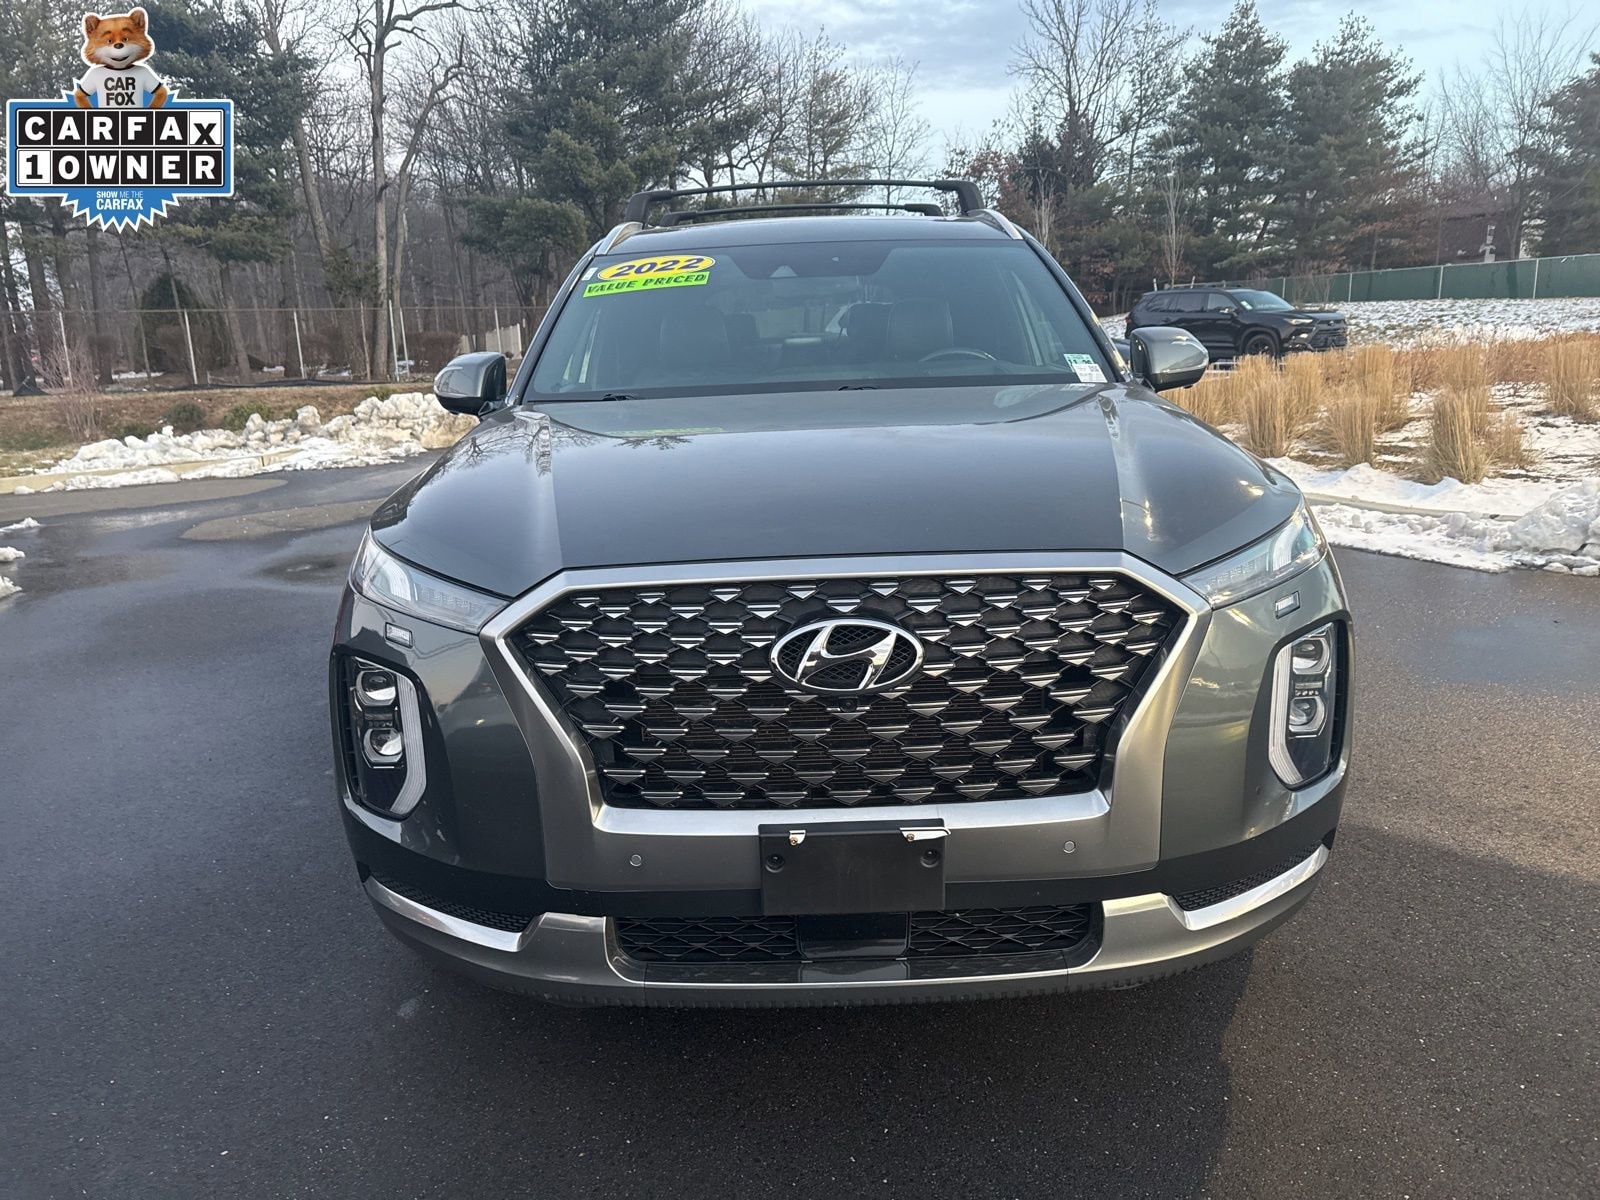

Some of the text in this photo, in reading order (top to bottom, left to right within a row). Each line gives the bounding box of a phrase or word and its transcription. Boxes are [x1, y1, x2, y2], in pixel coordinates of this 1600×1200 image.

[611, 258, 705, 278] 2022
[587, 274, 705, 294] VALUE PRICED
